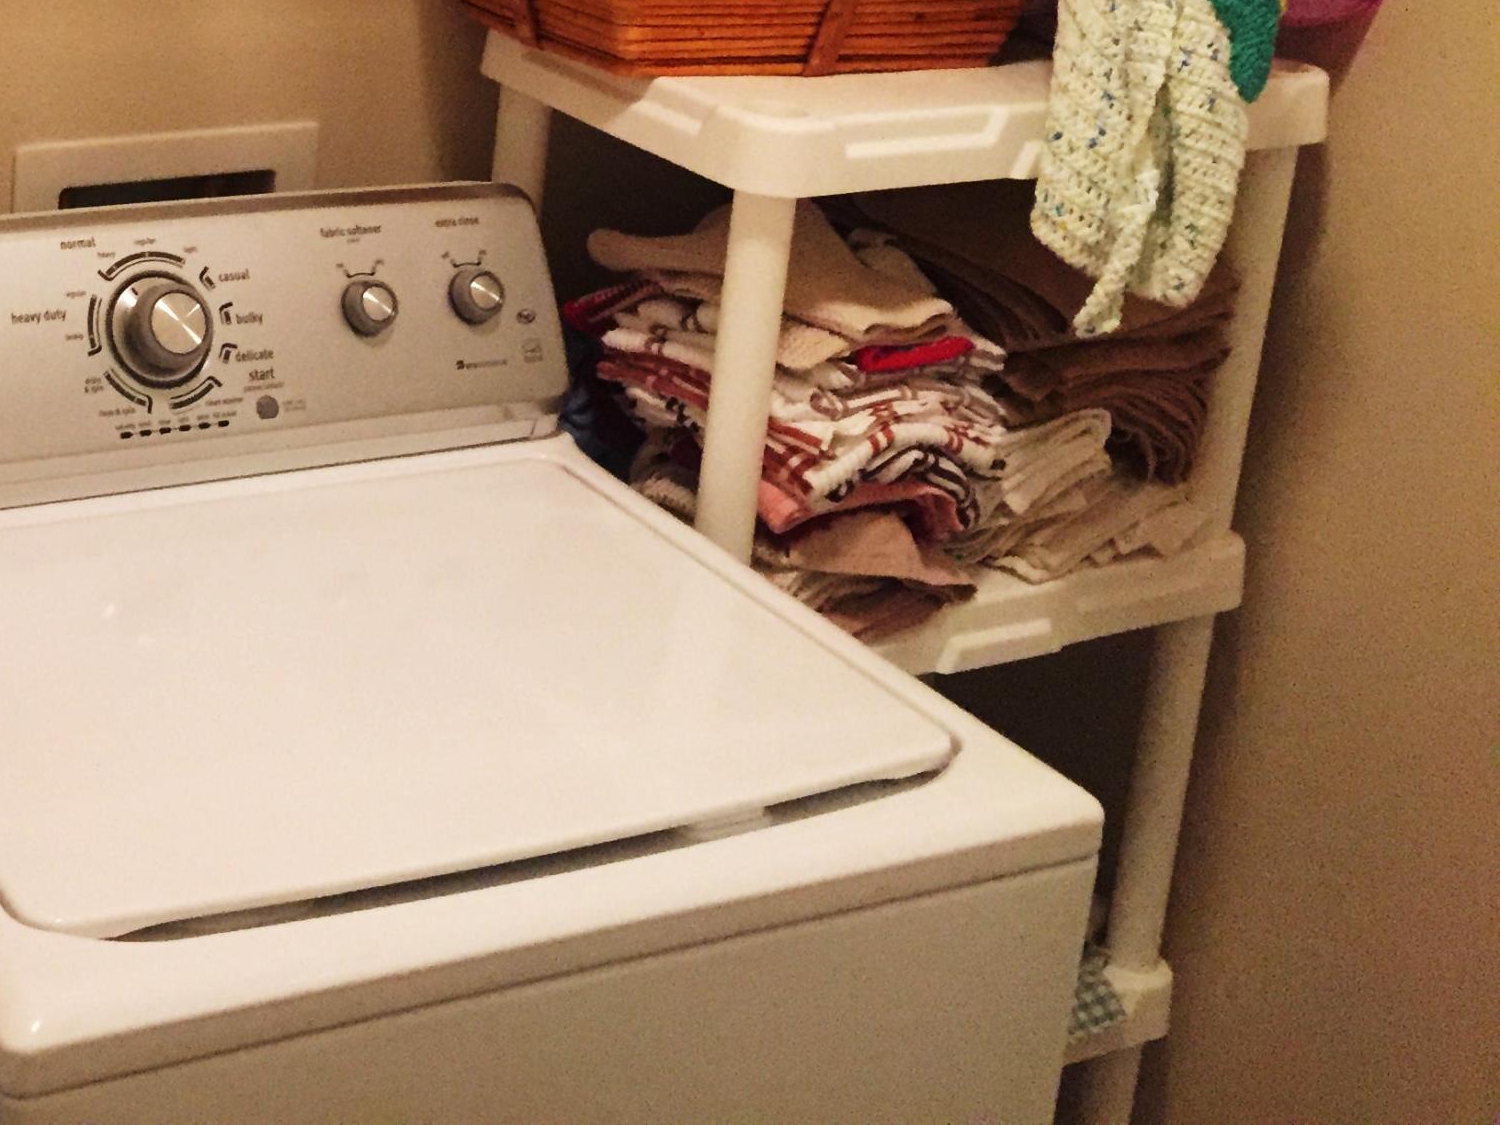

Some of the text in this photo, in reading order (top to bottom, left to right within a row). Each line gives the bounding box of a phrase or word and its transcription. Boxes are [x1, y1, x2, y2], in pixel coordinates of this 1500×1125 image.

[320, 225, 382, 238] fabric softener
[60, 236, 96, 250] normal
[218, 268, 250, 282] casual
[10, 309, 67, 325] heavy duty
[235, 312, 263, 325] bulky
[235, 348, 275, 363] delicate
[248, 368, 276, 382] start
